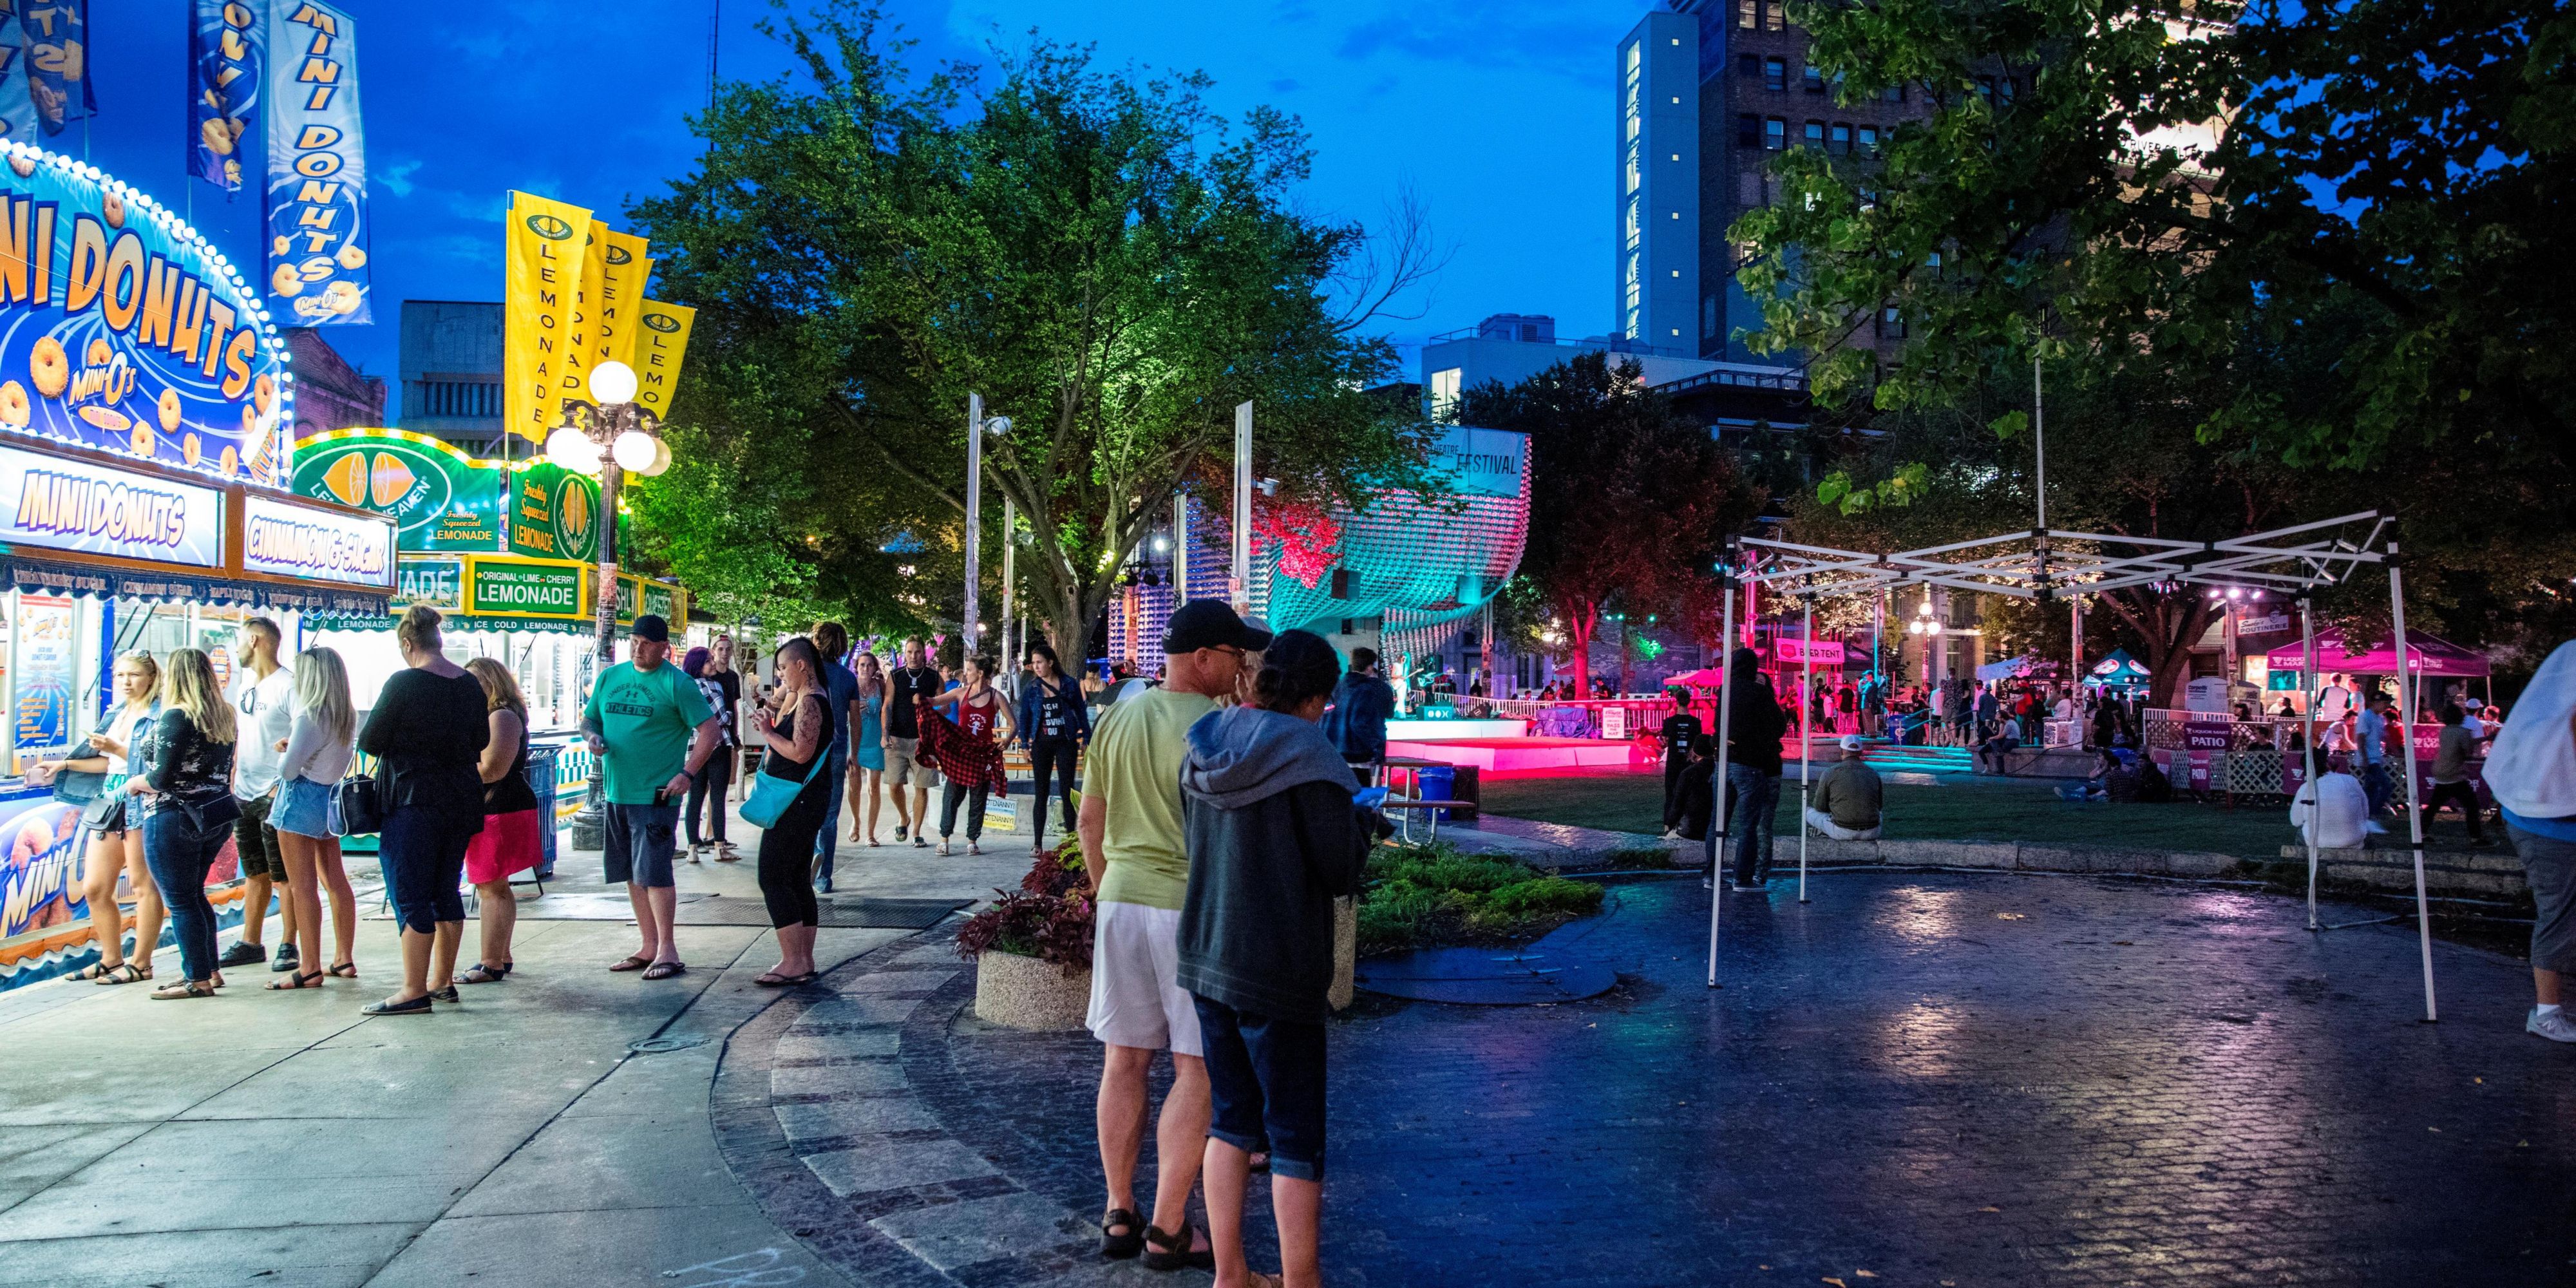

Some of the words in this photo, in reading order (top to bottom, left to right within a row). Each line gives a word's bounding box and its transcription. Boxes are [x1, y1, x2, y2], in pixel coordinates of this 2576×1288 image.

[285, 1, 343, 111] MINI
[292, 124, 344, 284] DONUTS
[65, 212, 257, 402] DONUTS
[533, 243, 556, 423] LEMONADE
[524, 479, 547, 506] Freshly
[14, 469, 91, 536] MINI
[90, 480, 185, 547] DONUTS
[446, 511, 478, 520] Freshly
[521, 498, 549, 522] Squeezed
[442, 519, 481, 528] Squeezed
[431, 531, 492, 540] LEMONADE
[515, 524, 553, 553] LEMONADE
[247, 515, 328, 569] CINNAMON
[328, 529, 343, 569] &
[343, 533, 385, 575] SUGAR
[482, 572, 518, 582] ORIGINAL
[523, 574, 540, 583] LIME
[547, 575, 575, 585] CHERRY
[478, 583, 573, 605] LEMONADE
[525, 622, 568, 630] LEMONADE
[2240, 623, 2288, 633] POUTINERIE
[1800, 648, 1819, 657] BER
[1821, 649, 1840, 658] TENT
[607, 683, 631, 699] UNDER
[632, 683, 656, 703] ARMOUR
[606, 703, 653, 716] ATHLETICS
[2192, 737, 2225, 747] PATIO
[2192, 768, 2207, 780] PATIO
[985, 813, 1014, 824] OTENANNY!
